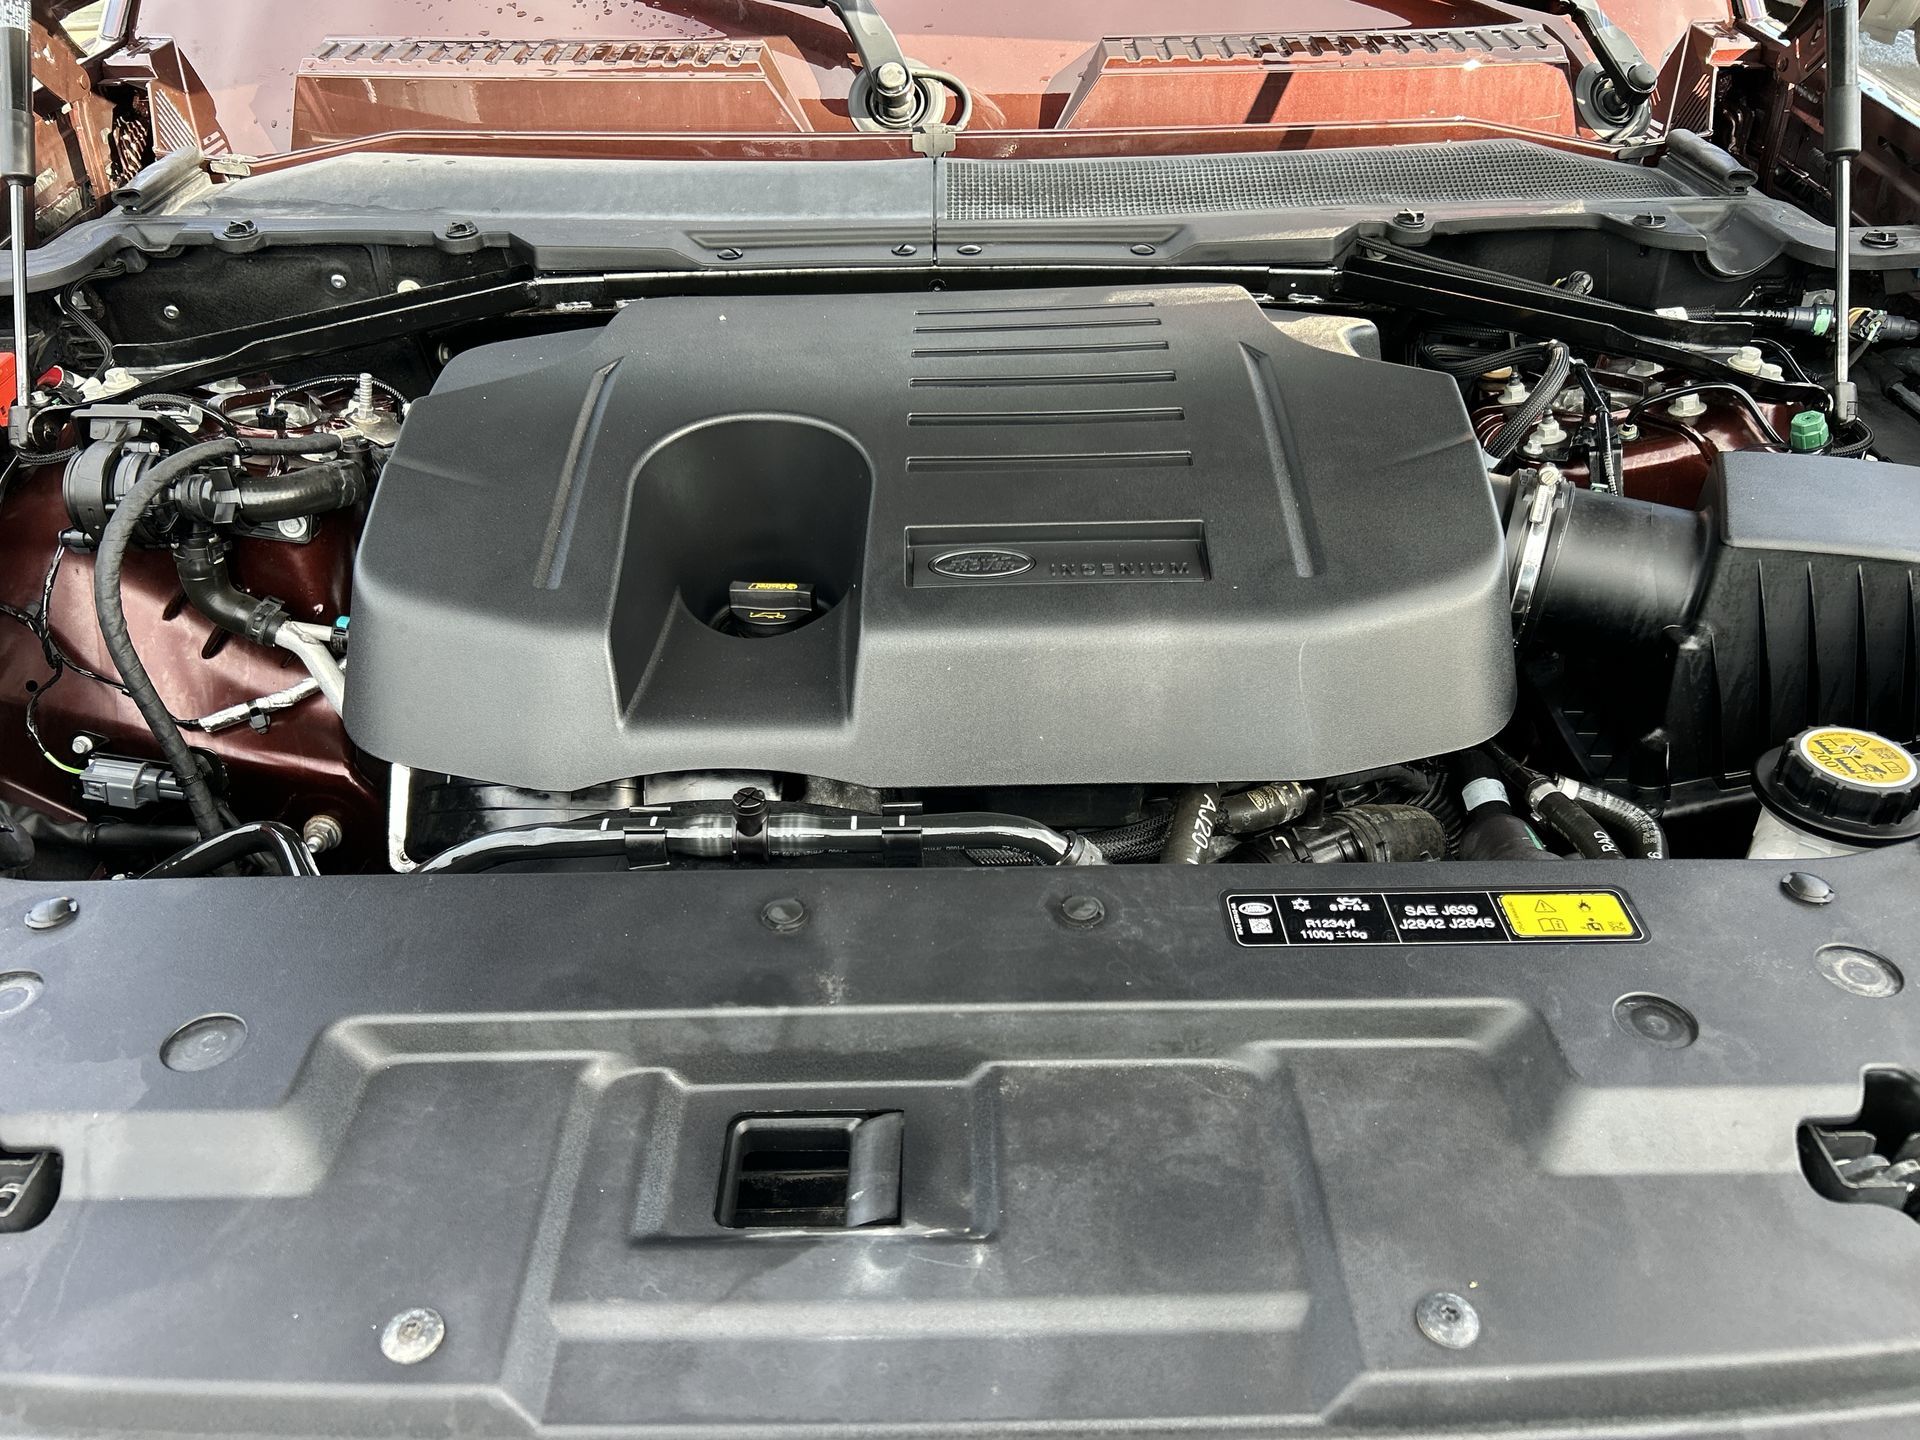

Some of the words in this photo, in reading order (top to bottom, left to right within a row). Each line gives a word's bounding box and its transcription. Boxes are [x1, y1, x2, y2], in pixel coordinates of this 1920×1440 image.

[1810, 750, 1839, 767] 200
[1404, 905, 1438, 916] SAE
[1441, 905, 1478, 915] J639
[1305, 918, 1356, 930] R1234yf
[1400, 918, 1446, 930] J2842
[1449, 917, 1496, 929] J2845
[1300, 930, 1334, 941] 1100g
